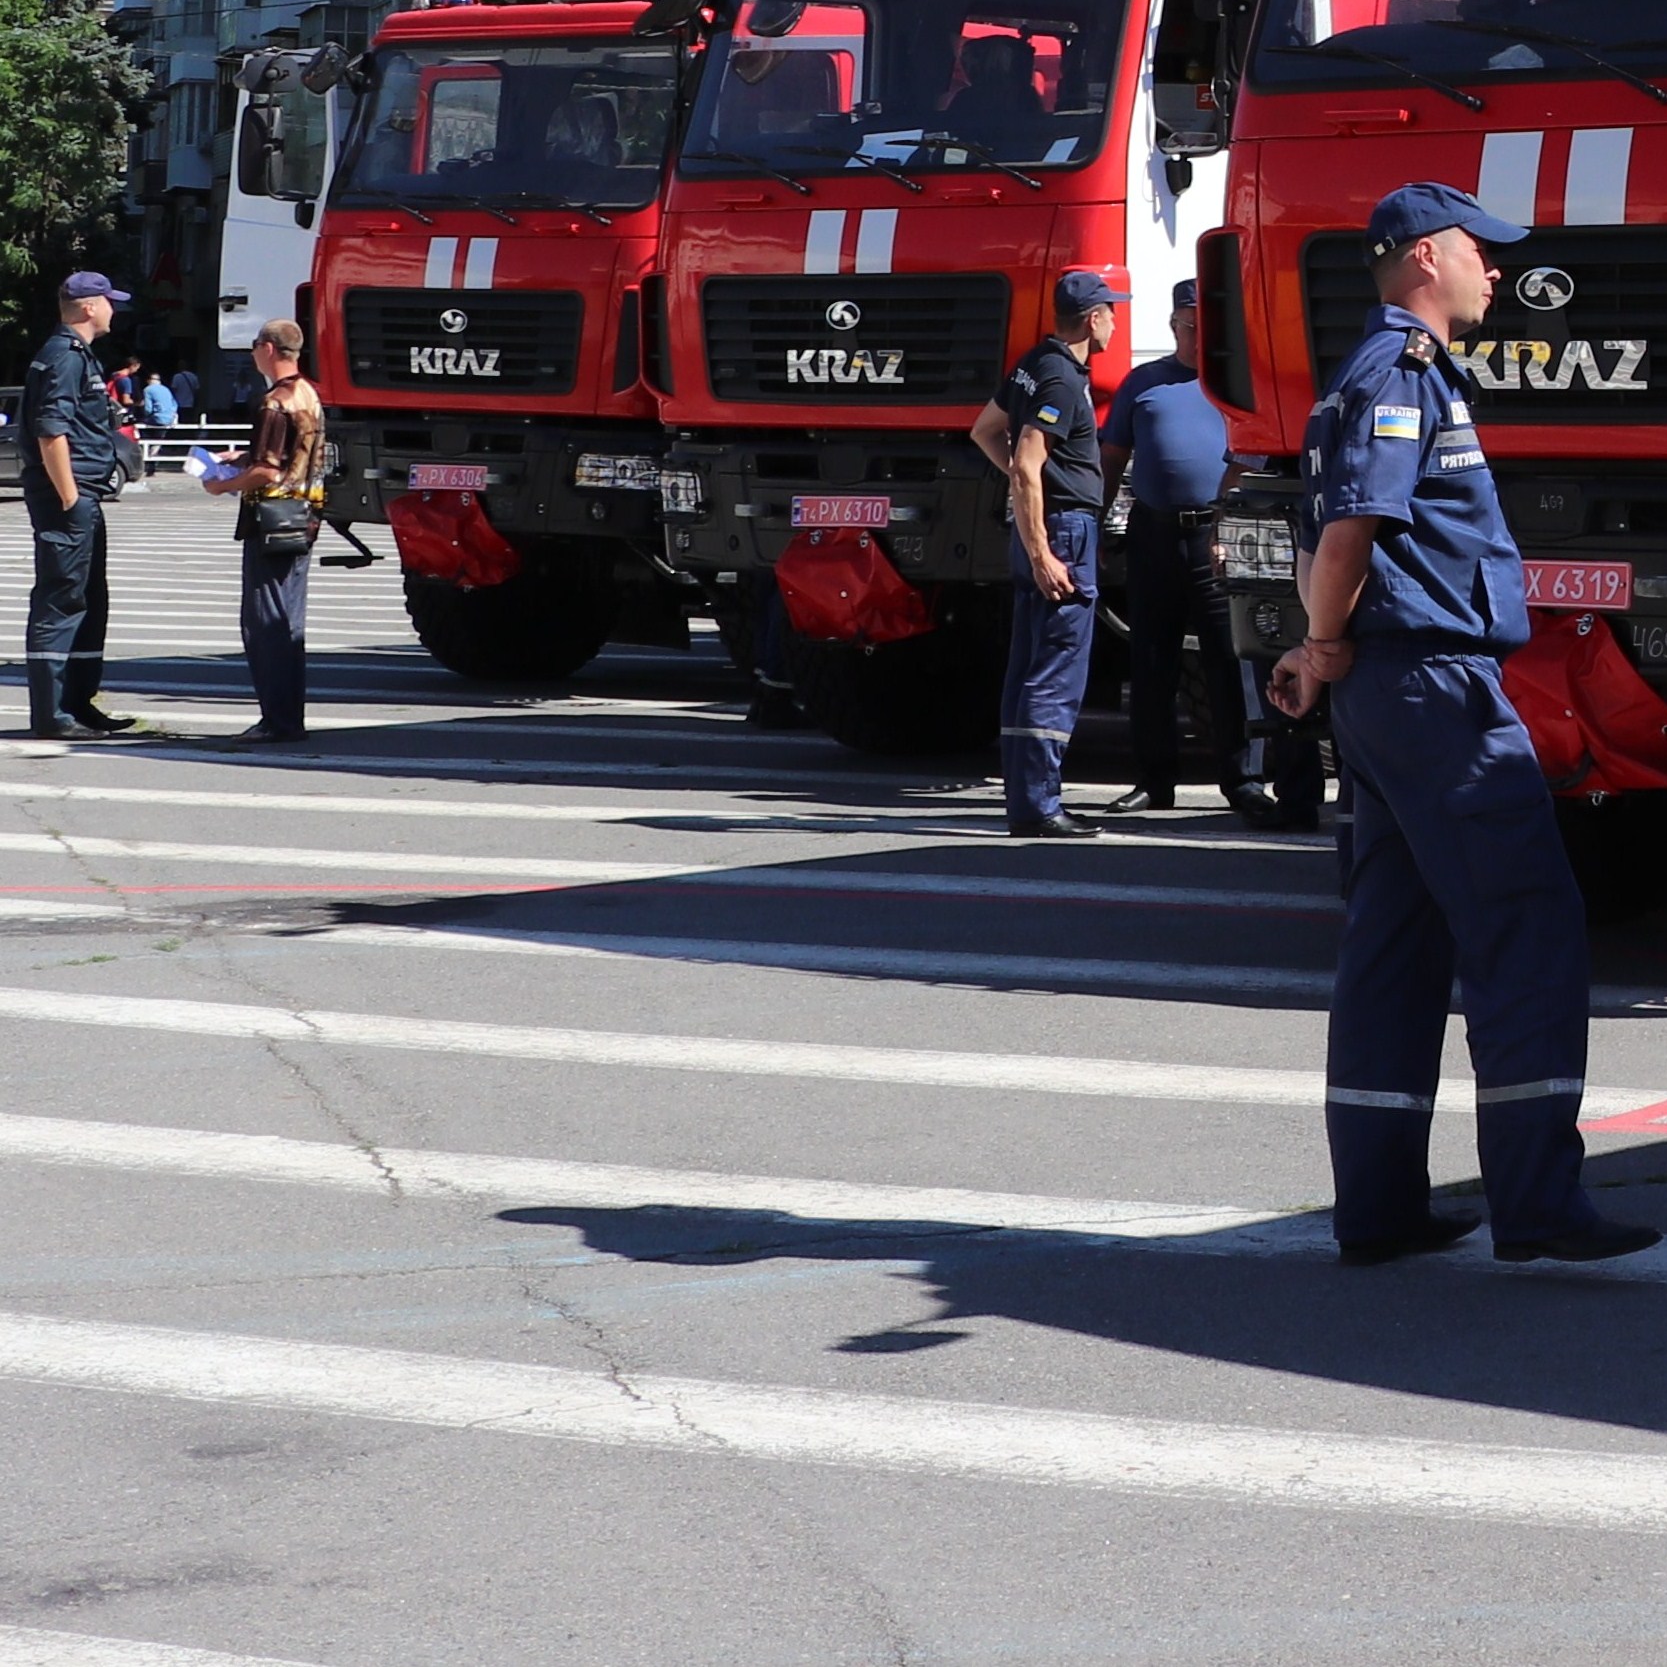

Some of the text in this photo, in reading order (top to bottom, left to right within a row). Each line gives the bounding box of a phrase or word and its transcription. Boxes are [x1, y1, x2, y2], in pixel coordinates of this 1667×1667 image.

[410, 346, 501, 377] KRAZ
[787, 349, 905, 384] KRAZ
[1449, 340, 1648, 390] KRAZ
[429, 468, 447, 485] PX
[450, 469, 482, 487] 6306
[803, 507, 816, 522] T4
[819, 502, 841, 522] PX
[844, 502, 884, 523] 6310
[1552, 569, 1620, 602] 6319
